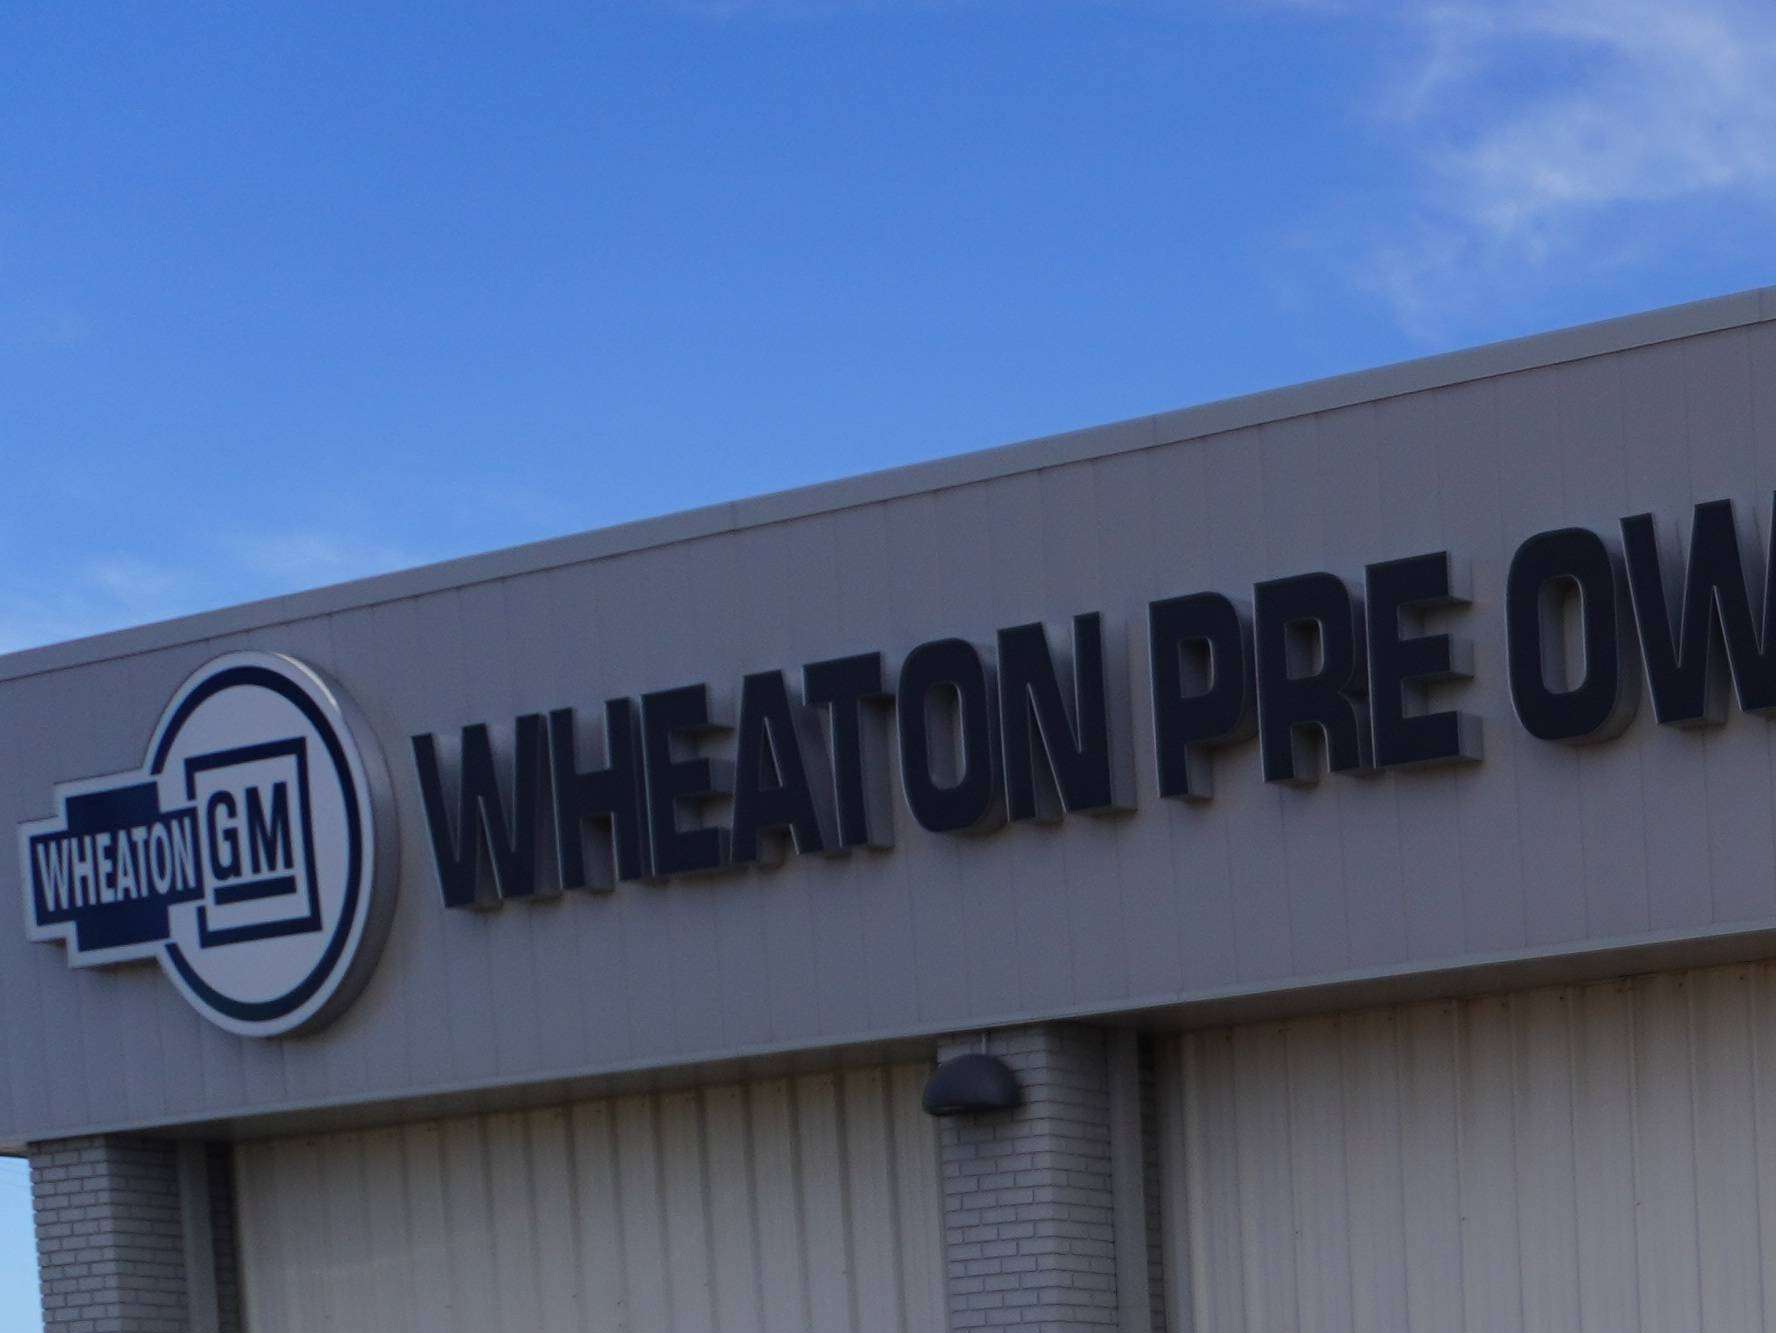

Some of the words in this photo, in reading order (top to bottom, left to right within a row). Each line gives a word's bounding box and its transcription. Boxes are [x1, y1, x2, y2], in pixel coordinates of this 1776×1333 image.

[36, 813, 198, 912] WHEATON
[206, 781, 294, 882] GM
[412, 611, 1122, 909] WHEATON
[1148, 551, 1474, 800] PRE
